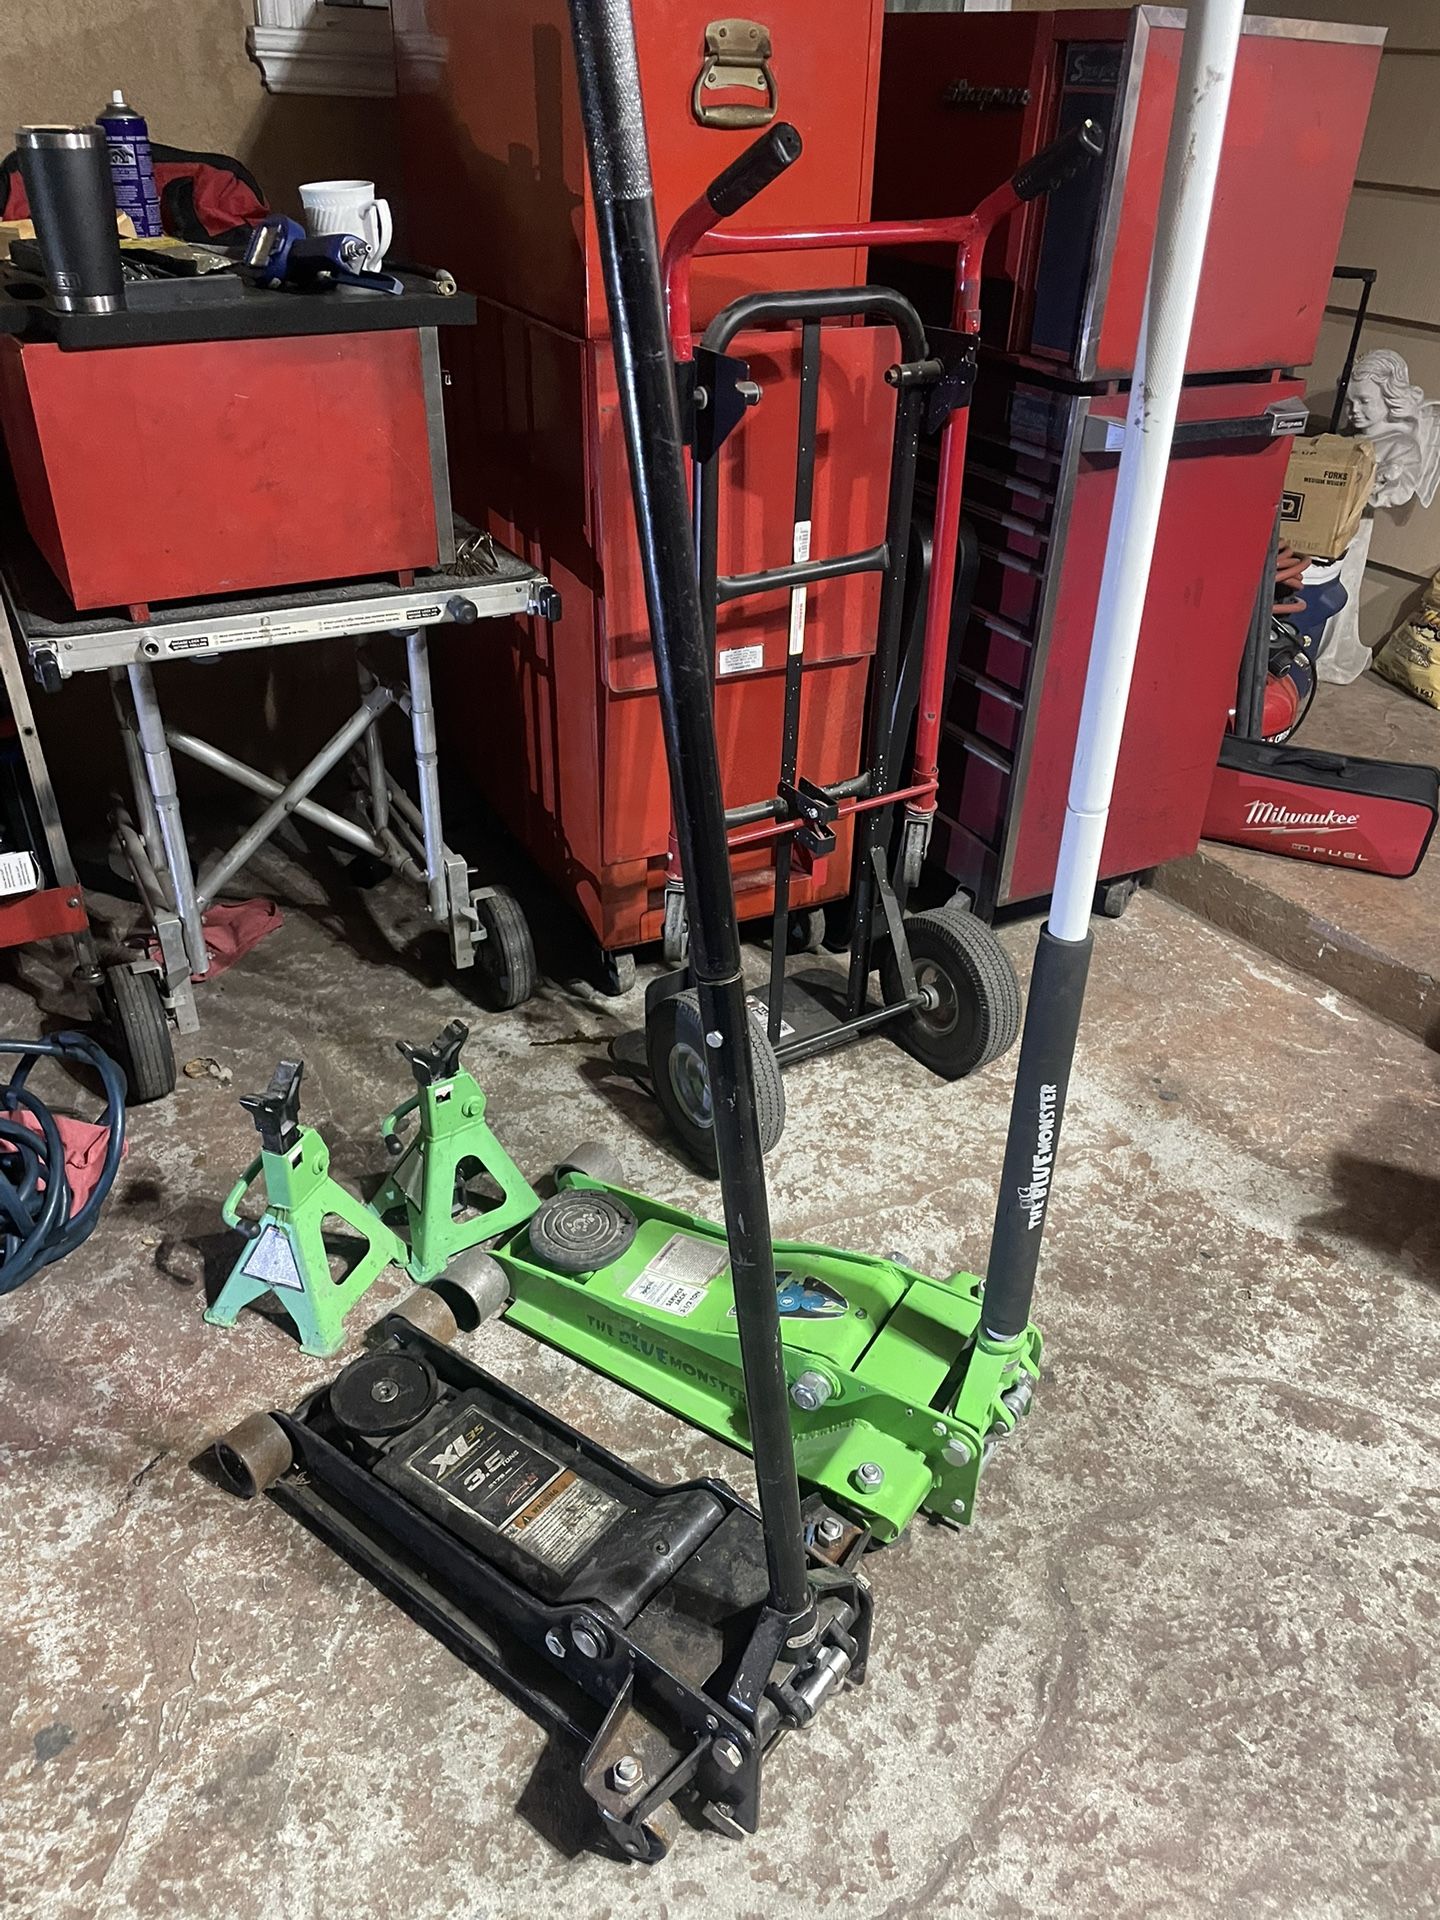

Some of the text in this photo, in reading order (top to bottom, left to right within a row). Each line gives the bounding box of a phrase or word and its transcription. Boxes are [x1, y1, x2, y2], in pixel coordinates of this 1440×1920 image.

[1303, 477, 1347, 488] MEDIUM WEIGHT
[1323, 470, 1348, 481] FORKS
[1243, 799, 1360, 826] Milwaukee
[1312, 847, 1369, 861] FUEL
[1028, 1083, 1057, 1230] THE BLUE MONSTER
[585, 1314, 745, 1403] THE BLUE MONSTER
[428, 1433, 481, 1480] XL
[465, 1422, 485, 1443] 35
[463, 1449, 505, 1492] 3.5
[500, 1449, 520, 1468] TONS
[531, 1488, 560, 1514] WARNING
